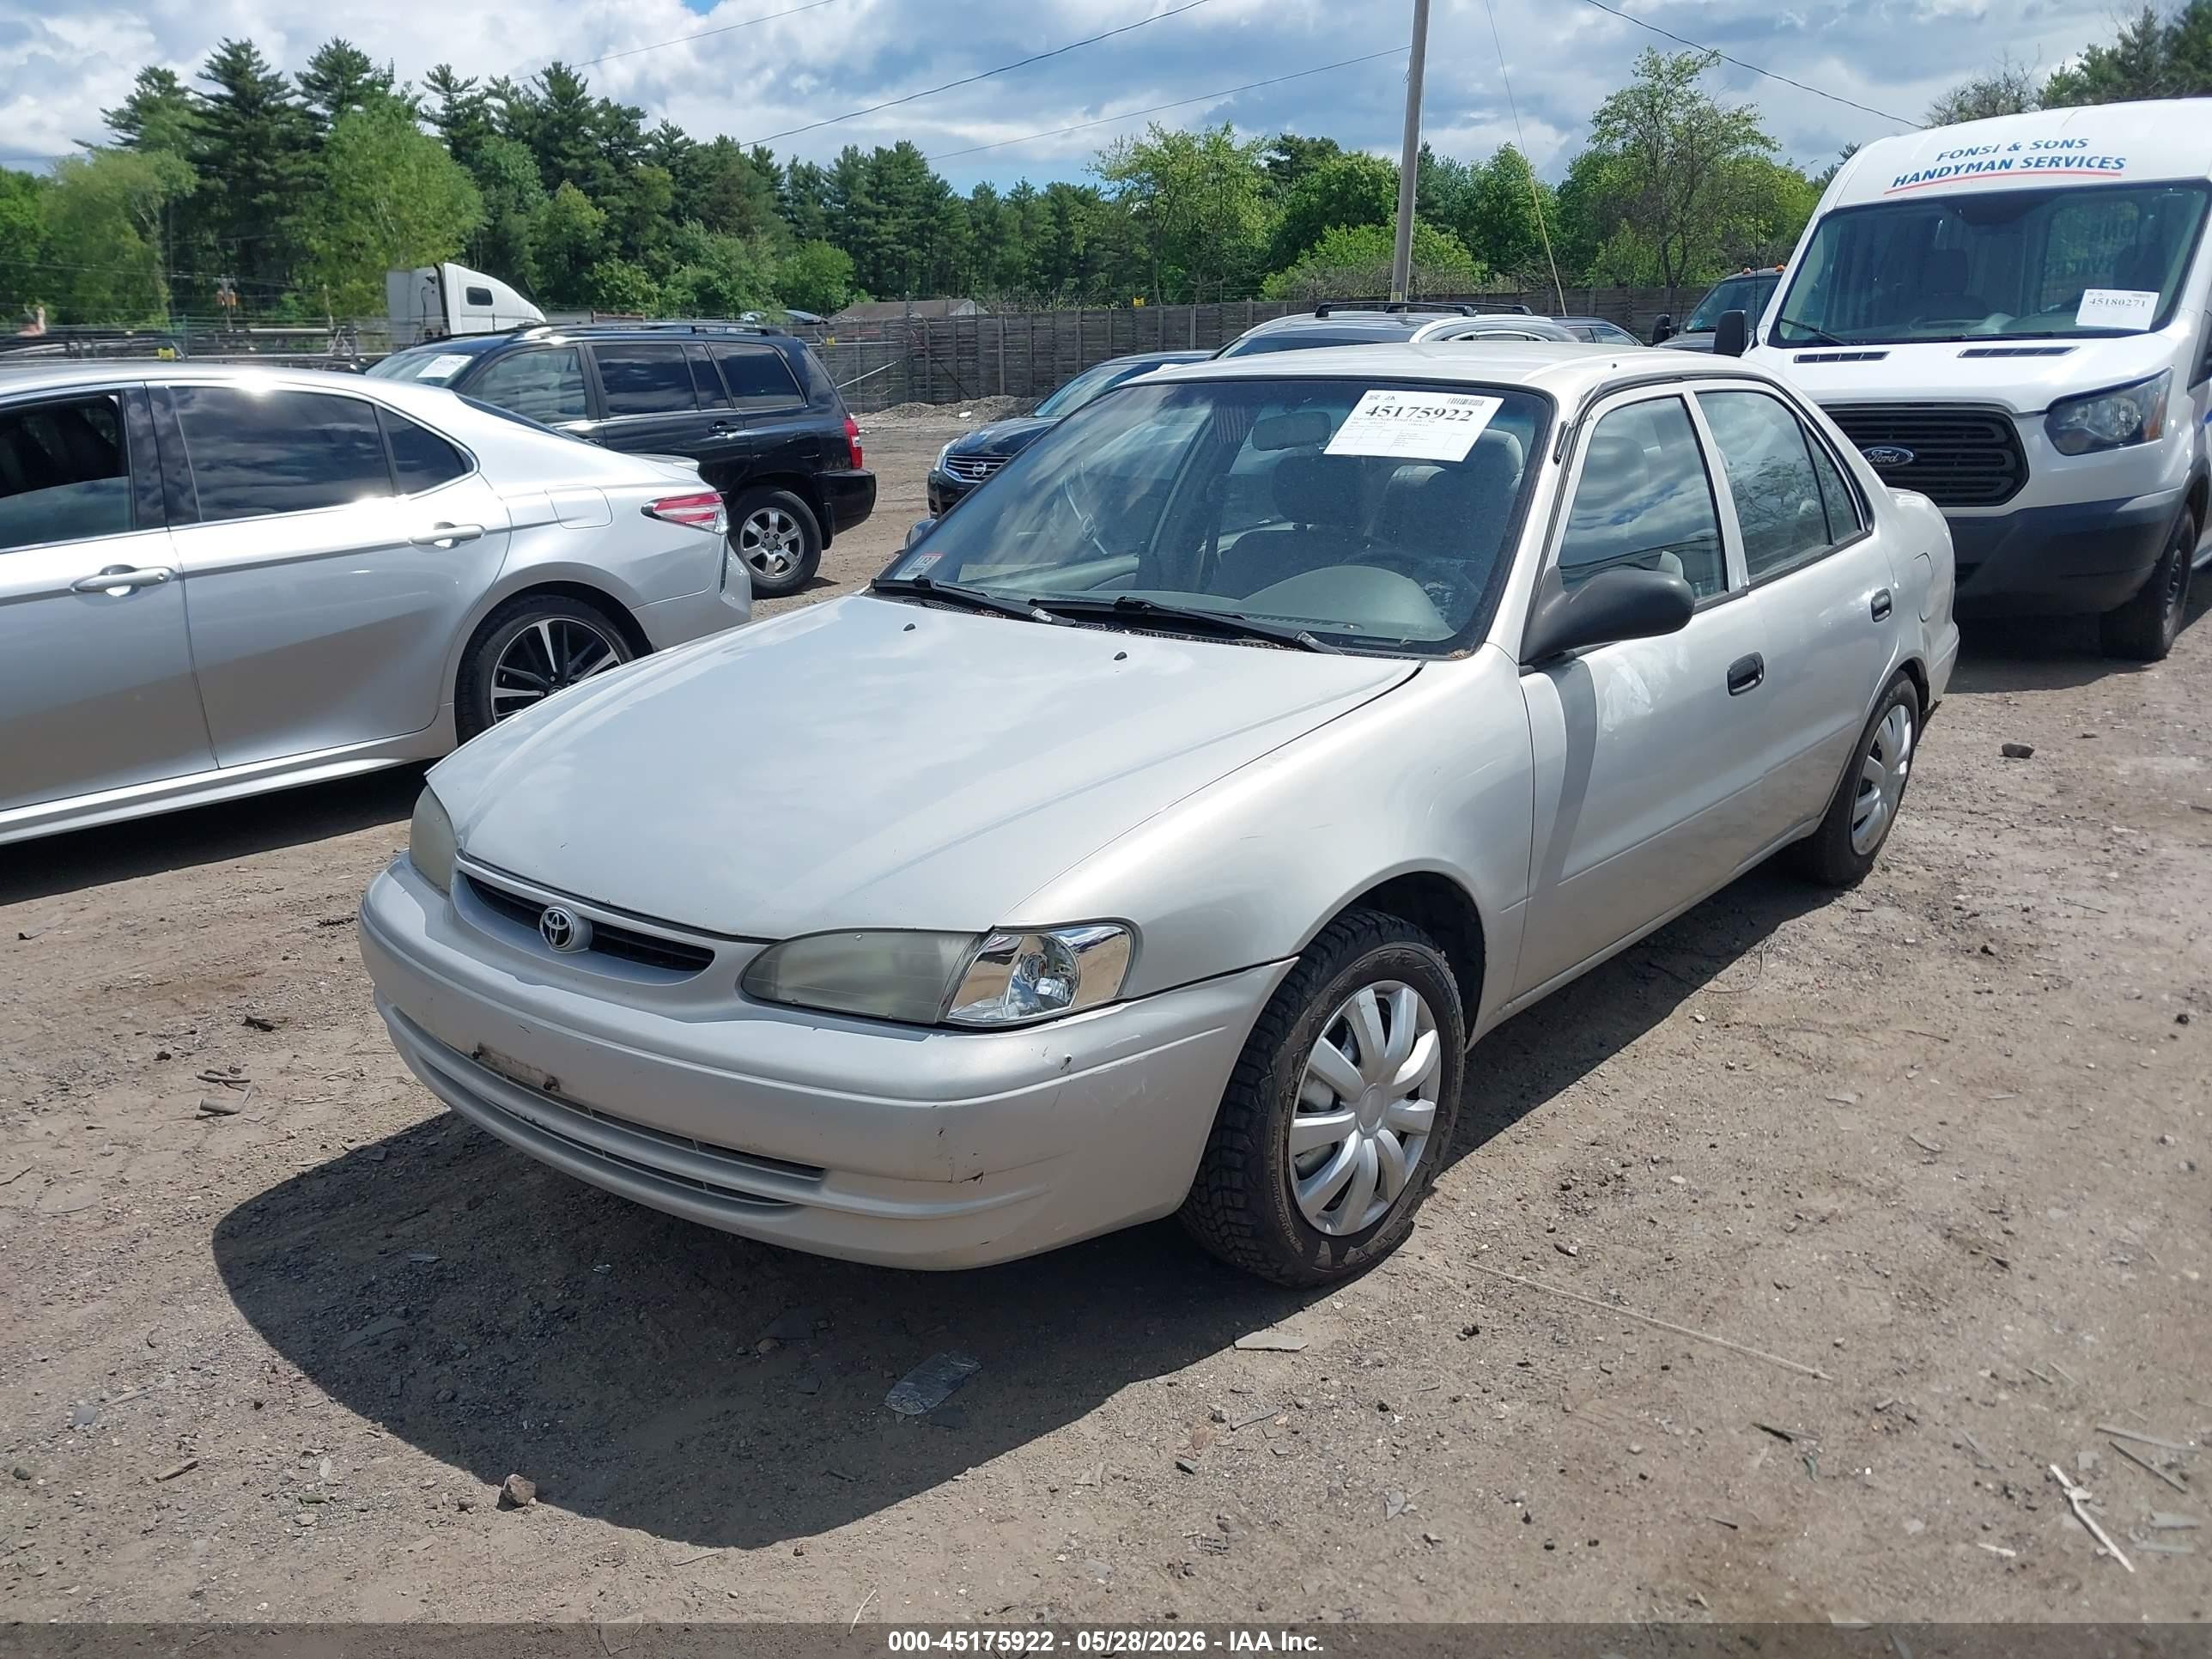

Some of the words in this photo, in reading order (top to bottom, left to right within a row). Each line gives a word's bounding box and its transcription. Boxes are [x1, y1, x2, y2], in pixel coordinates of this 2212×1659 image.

[1936, 143, 2001, 162] FONSI
[2007, 141, 2022, 152] &
[2029, 137, 2089, 149] SONS
[1891, 157, 2014, 188] HANDYMAN
[2019, 155, 2127, 170] SERVICES
[2089, 297, 2145, 307] 45180271
[1365, 404, 1474, 422] 45175922
[1868, 449, 1899, 463] Ford
